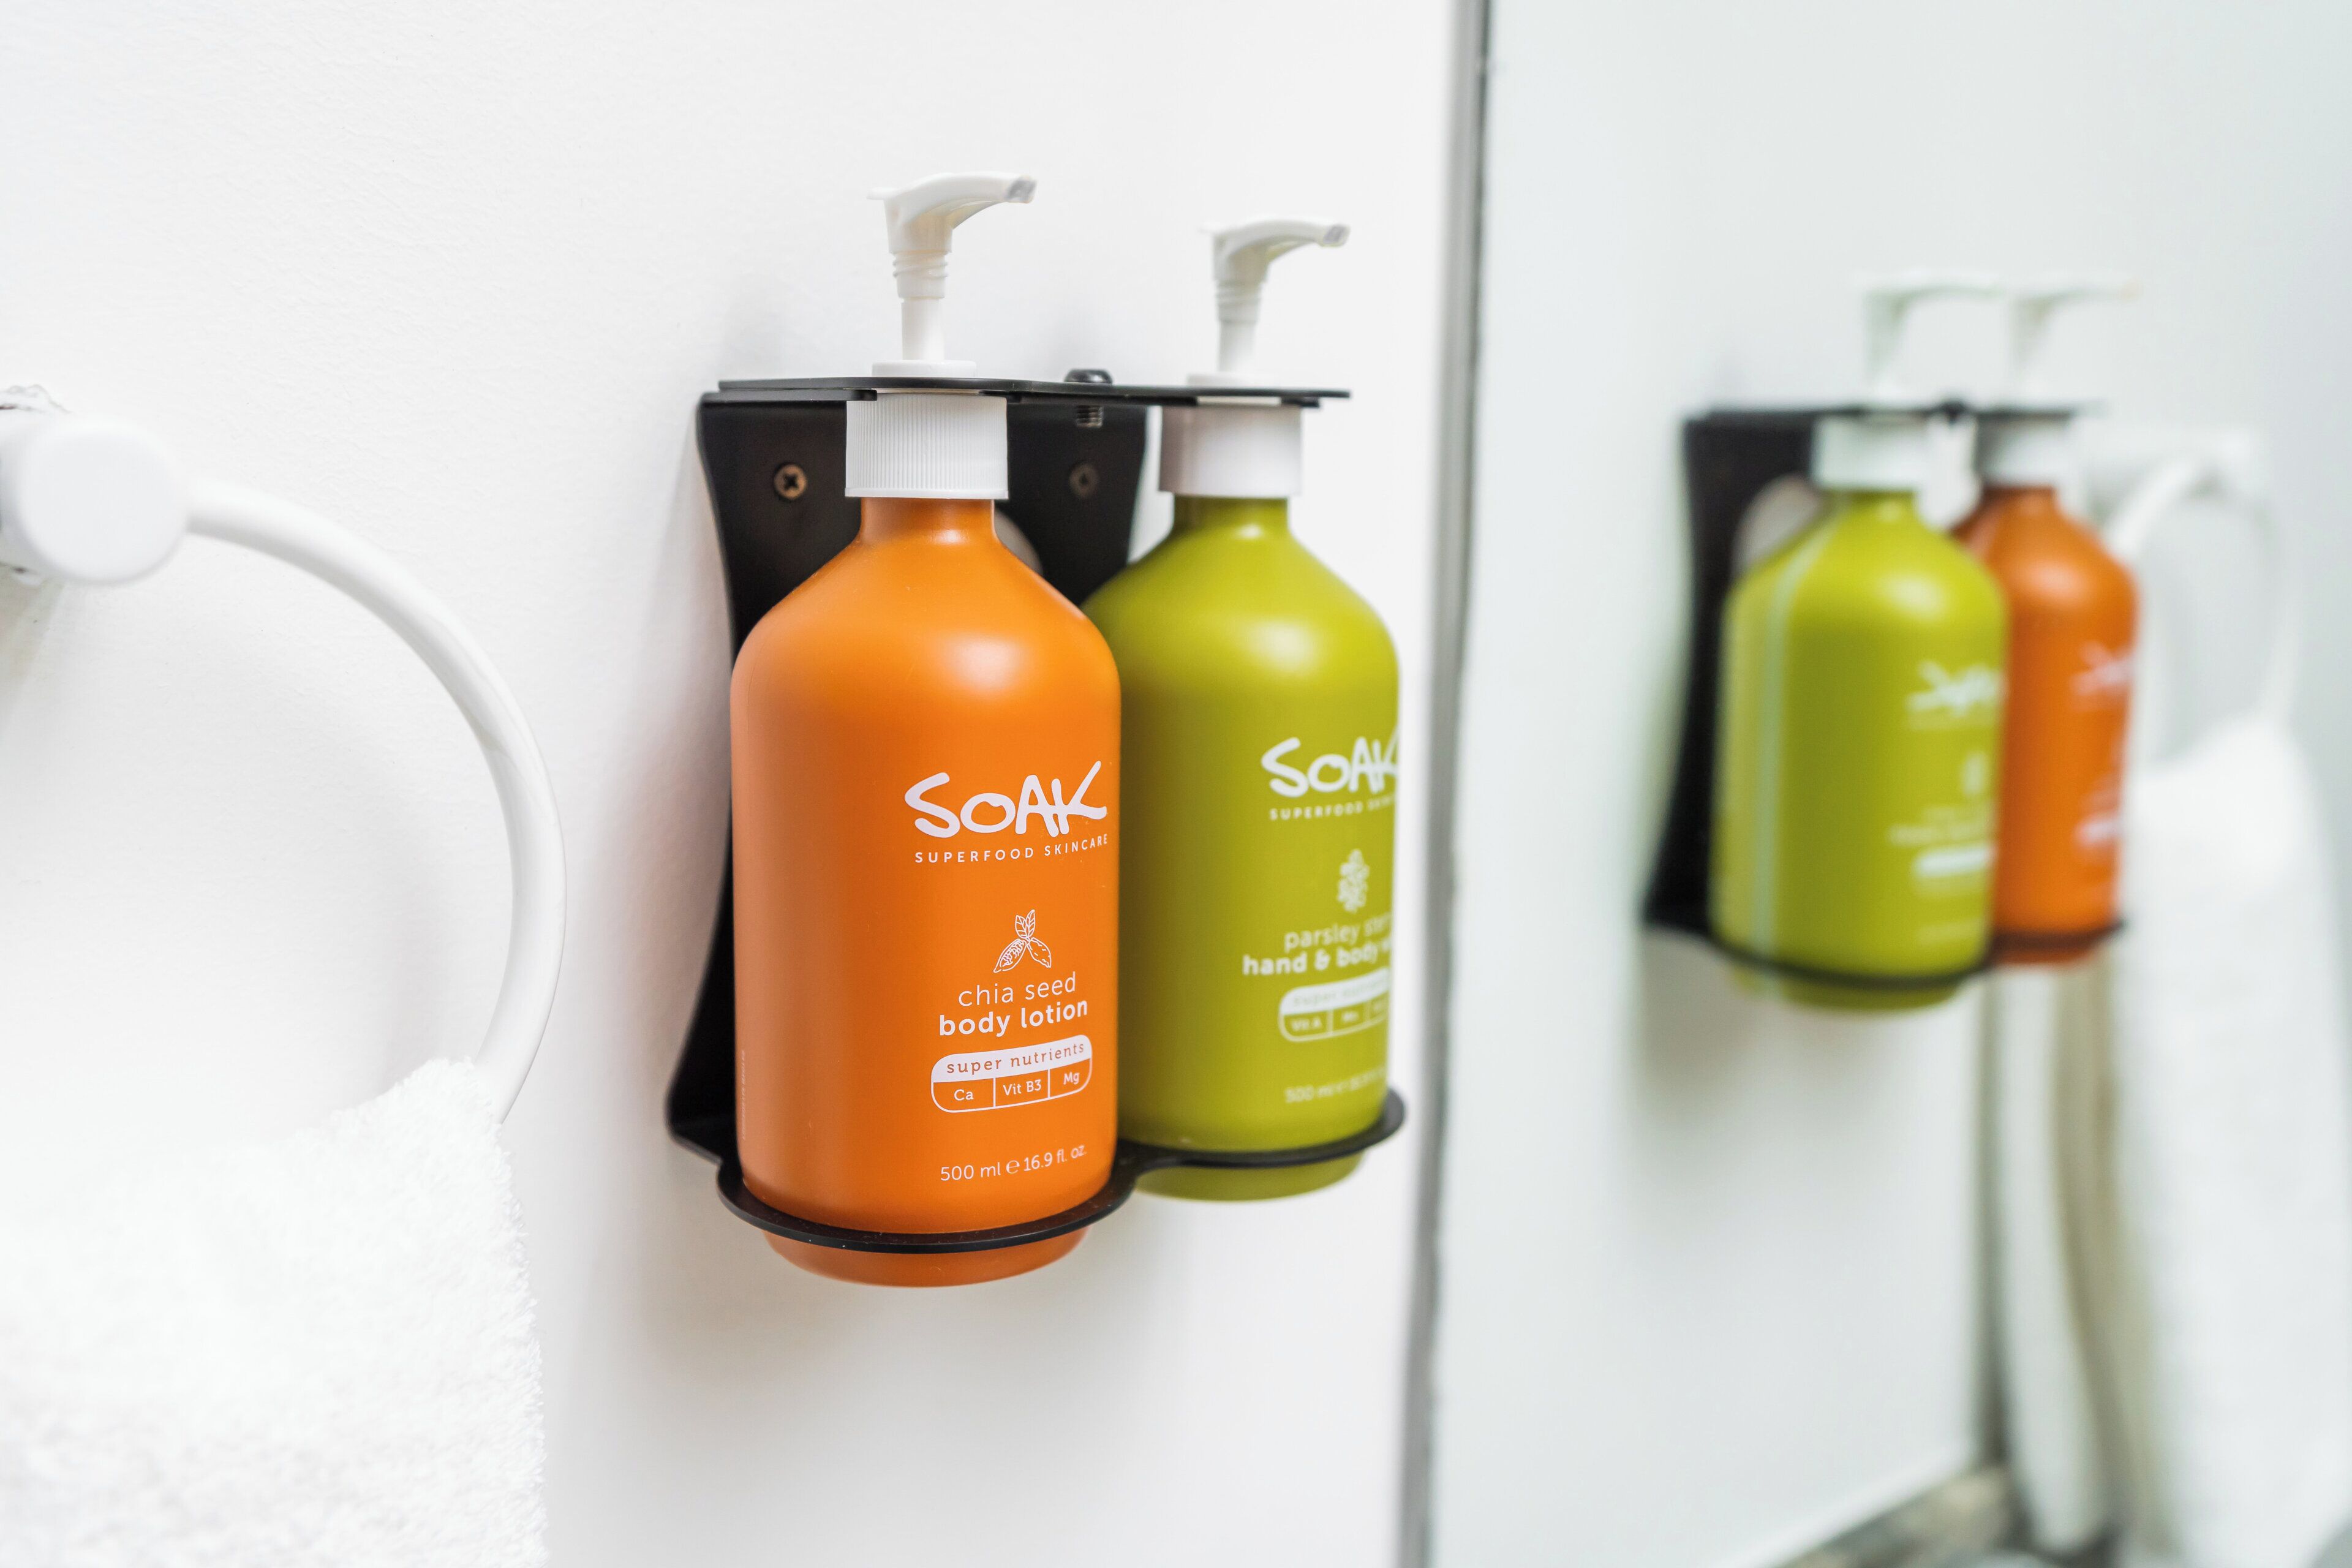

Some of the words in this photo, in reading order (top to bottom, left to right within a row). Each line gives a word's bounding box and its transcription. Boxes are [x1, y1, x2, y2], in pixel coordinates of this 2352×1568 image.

[1270, 801, 1363, 820] SUPERFOOD
[915, 847, 1033, 863] SUPERFOOD
[1044, 834, 1107, 856] SKINCARE
[1284, 924, 1360, 953] parsley
[1243, 952, 1307, 975] hand
[1314, 949, 1330, 970] &
[1336, 942, 1378, 968] body
[959, 983, 1013, 1006] chia
[1025, 971, 1076, 1000] seed
[939, 1011, 1011, 1037] body
[1021, 1000, 1087, 1028] lotion
[947, 1058, 1001, 1074] super
[1011, 1042, 1084, 1067] nutrients
[954, 1089, 974, 1101] Ca
[1003, 1083, 1021, 1095] Vit
[1027, 1079, 1041, 1093] B3
[1063, 1072, 1080, 1085] Mg
[940, 1165, 974, 1181] 500
[981, 1161, 1001, 1177] ml
[1023, 1152, 1053, 1171] 16.9
[1057, 1149, 1067, 1163] fl.
[1071, 1145, 1087, 1159] oz.
